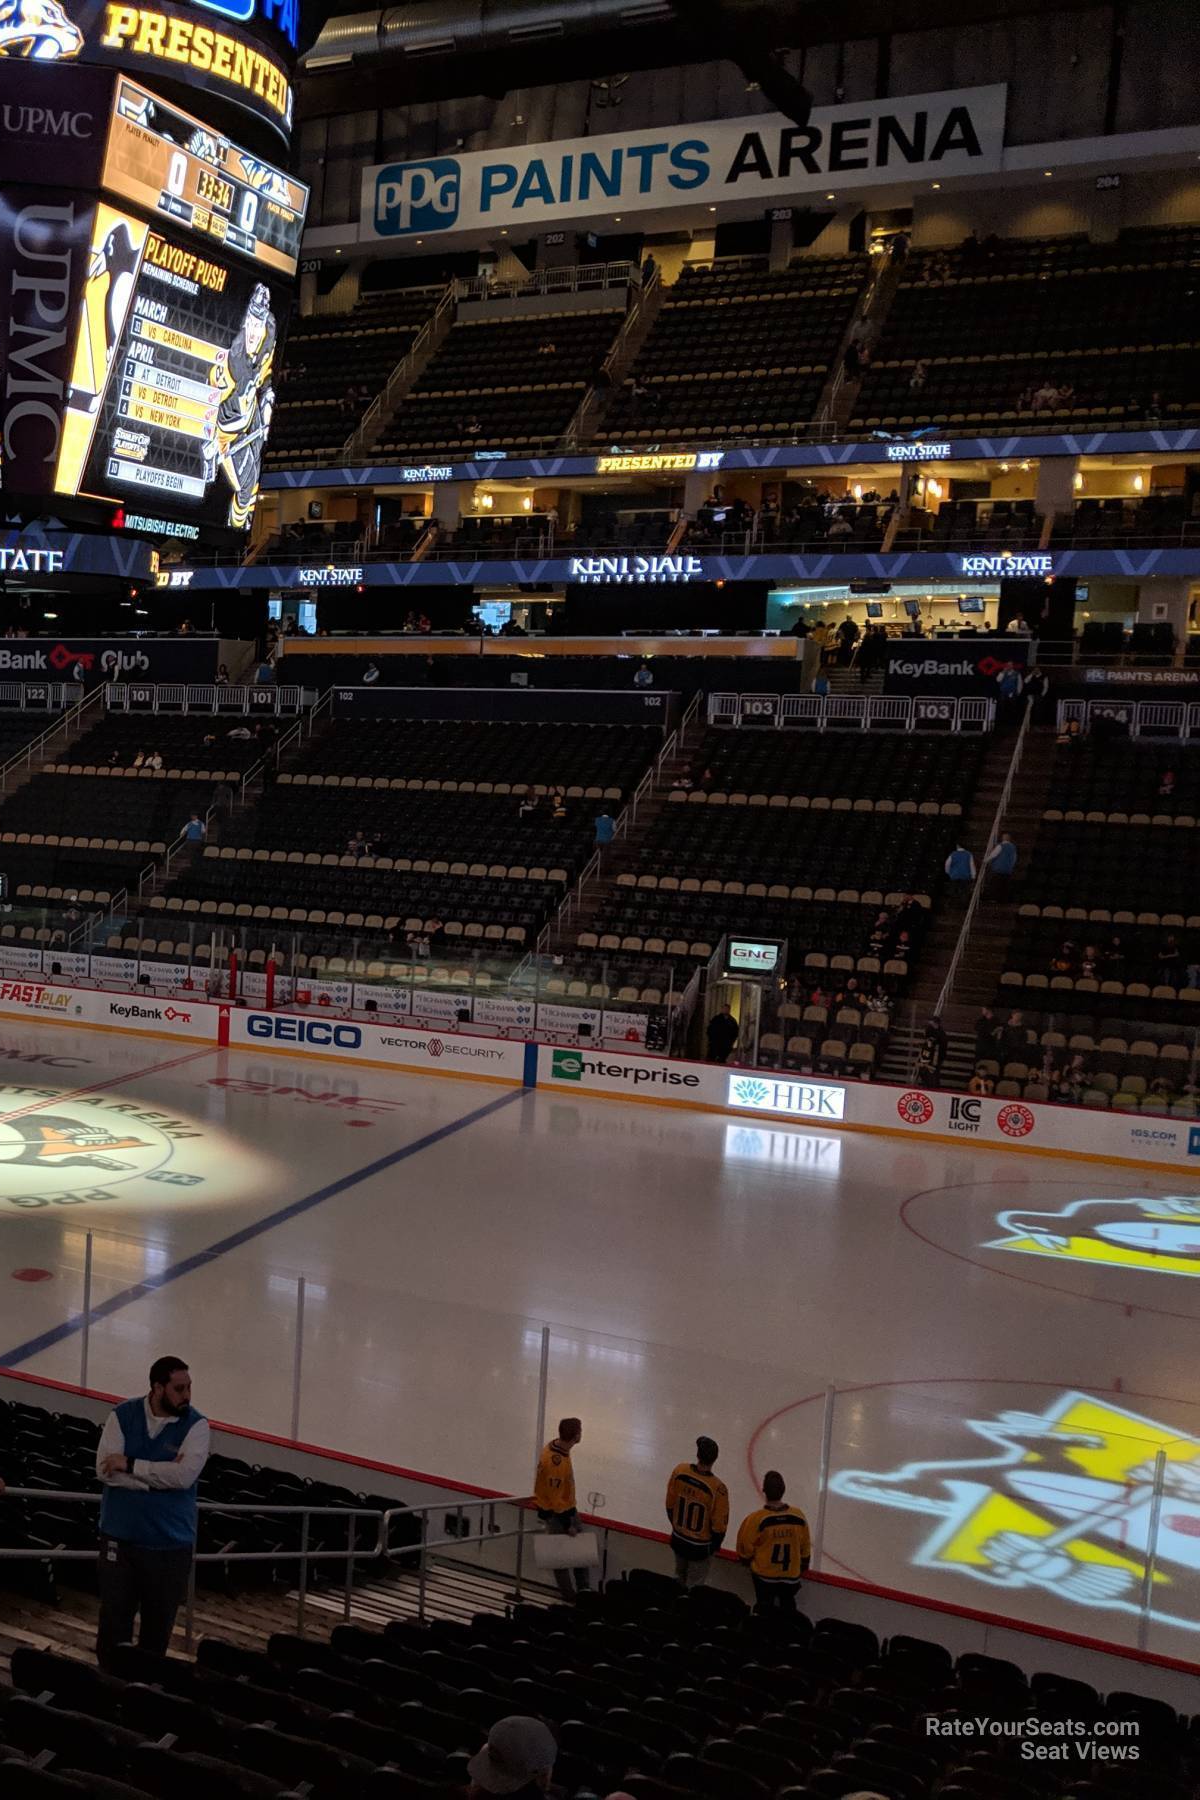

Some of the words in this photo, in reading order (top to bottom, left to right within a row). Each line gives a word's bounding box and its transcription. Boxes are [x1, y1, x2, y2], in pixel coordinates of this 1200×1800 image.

[102, 4, 289, 117] PRESENTED
[2, 104, 93, 138] UPMC
[167, 151, 188, 197] 0
[379, 167, 456, 230] PPG
[479, 139, 710, 212] PAINTS
[724, 105, 982, 184] ARENA
[199, 172, 231, 210] 33:34
[239, 190, 258, 232] 0
[144, 236, 198, 278] PLAYOFF
[195, 258, 227, 292] PUSH
[142, 262, 172, 284] REMAINING
[172, 274, 200, 295] SCHEDULE
[134, 296, 168, 323] MARCH
[2, 202, 75, 465] UPMC
[163, 329, 192, 351] CAROLINA
[127, 341, 154, 364] APRIL
[156, 373, 181, 391] DETROIT
[153, 391, 178, 408] DETROIT
[888, 446, 918, 458] KENT
[918, 444, 950, 456] STATE
[598, 454, 697, 473] PRESENTED
[697, 452, 725, 469] BY
[135, 469, 165, 486] PLAYOFFS
[166, 475, 183, 489] BEGIN
[404, 467, 427, 479] KENT
[427, 466, 452, 478] STATE
[124, 514, 166, 534] MITSUBISHI
[166, 522, 200, 540] ELECTRIC
[962, 557, 1003, 571] KENT
[1006, 556, 1052, 570] STATE
[170, 571, 194, 586] BY
[300, 570, 329, 583] KENT
[331, 568, 362, 581] STATE
[580, 572, 692, 583] UNIVERSITY
[101, 649, 149, 671] Club
[889, 659, 974, 678] KeyBank
[1107, 671, 1152, 681] PAINTS
[1155, 671, 1199, 682] ARENA
[27, 688, 45, 700] 122
[132, 690, 150, 701] 101
[252, 691, 273, 705] 101
[339, 693, 353, 701] 102
[644, 697, 661, 706] 102
[744, 700, 774, 716] 103
[919, 705, 949, 719] 103
[733, 948, 776, 960] GNC
[0, 983, 45, 1004] FAST
[41, 992, 73, 1007] PLAY
[110, 1003, 163, 1020] KeyBank
[246, 1014, 362, 1049] GEICO
[380, 1036, 427, 1051] VECTOR
[444, 1044, 504, 1060] SECURITY
[559, 1053, 700, 1088] enterprise
[772, 1083, 839, 1115] HBK
[899, 1093, 917, 1108] IRON
[918, 1093, 931, 1111] CITY
[74, 1096, 204, 1140] ARENA
[904, 1112, 927, 1123] BEER
[950, 1097, 982, 1123] IC
[1000, 1106, 1019, 1120] IRON
[1020, 1106, 1033, 1124] CITY
[948, 1121, 980, 1132] LIGHT
[1130, 1129, 1177, 1141] IGS.COM
[7, 1189, 119, 1208] PPG
[676, 1495, 706, 1532] 10
[771, 1543, 791, 1572] 4
